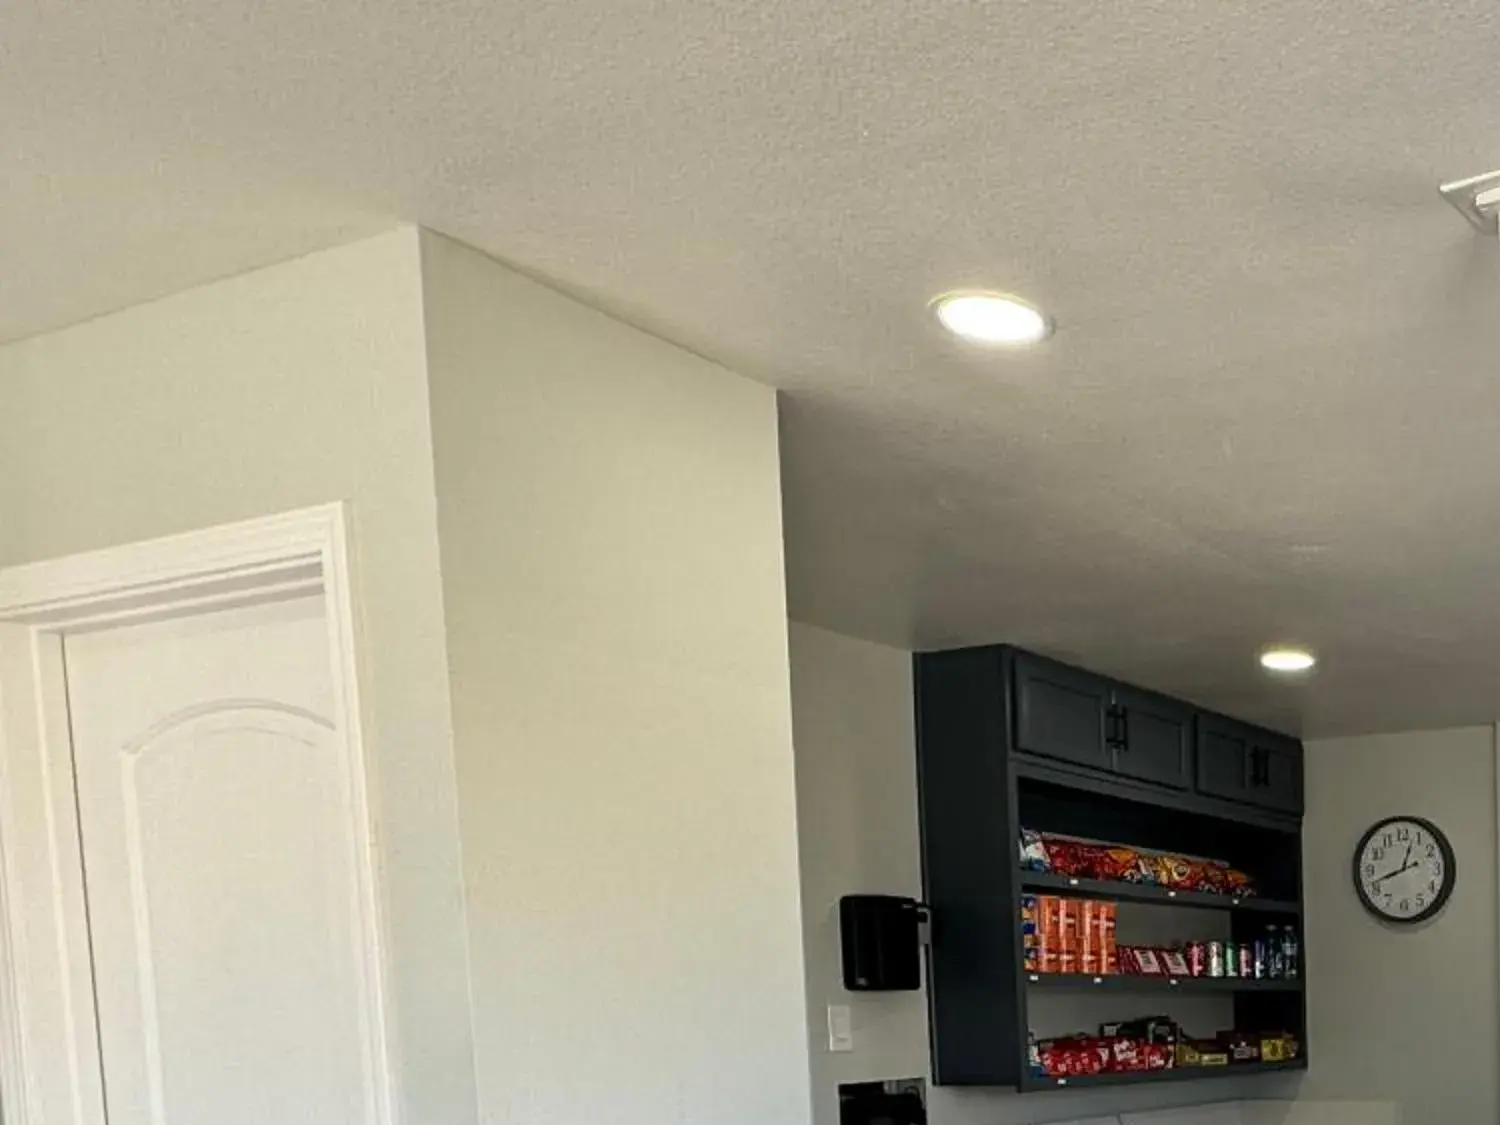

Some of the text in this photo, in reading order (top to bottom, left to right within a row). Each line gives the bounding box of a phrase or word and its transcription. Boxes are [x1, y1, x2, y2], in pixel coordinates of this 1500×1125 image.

[1383, 834, 1392, 848] 11
[1397, 827, 1408, 841] 12
[1372, 846, 1384, 861] 10
[1426, 843, 1434, 858] 2
[1384, 893, 1392, 906] 7
[1416, 893, 1424, 906] 5
